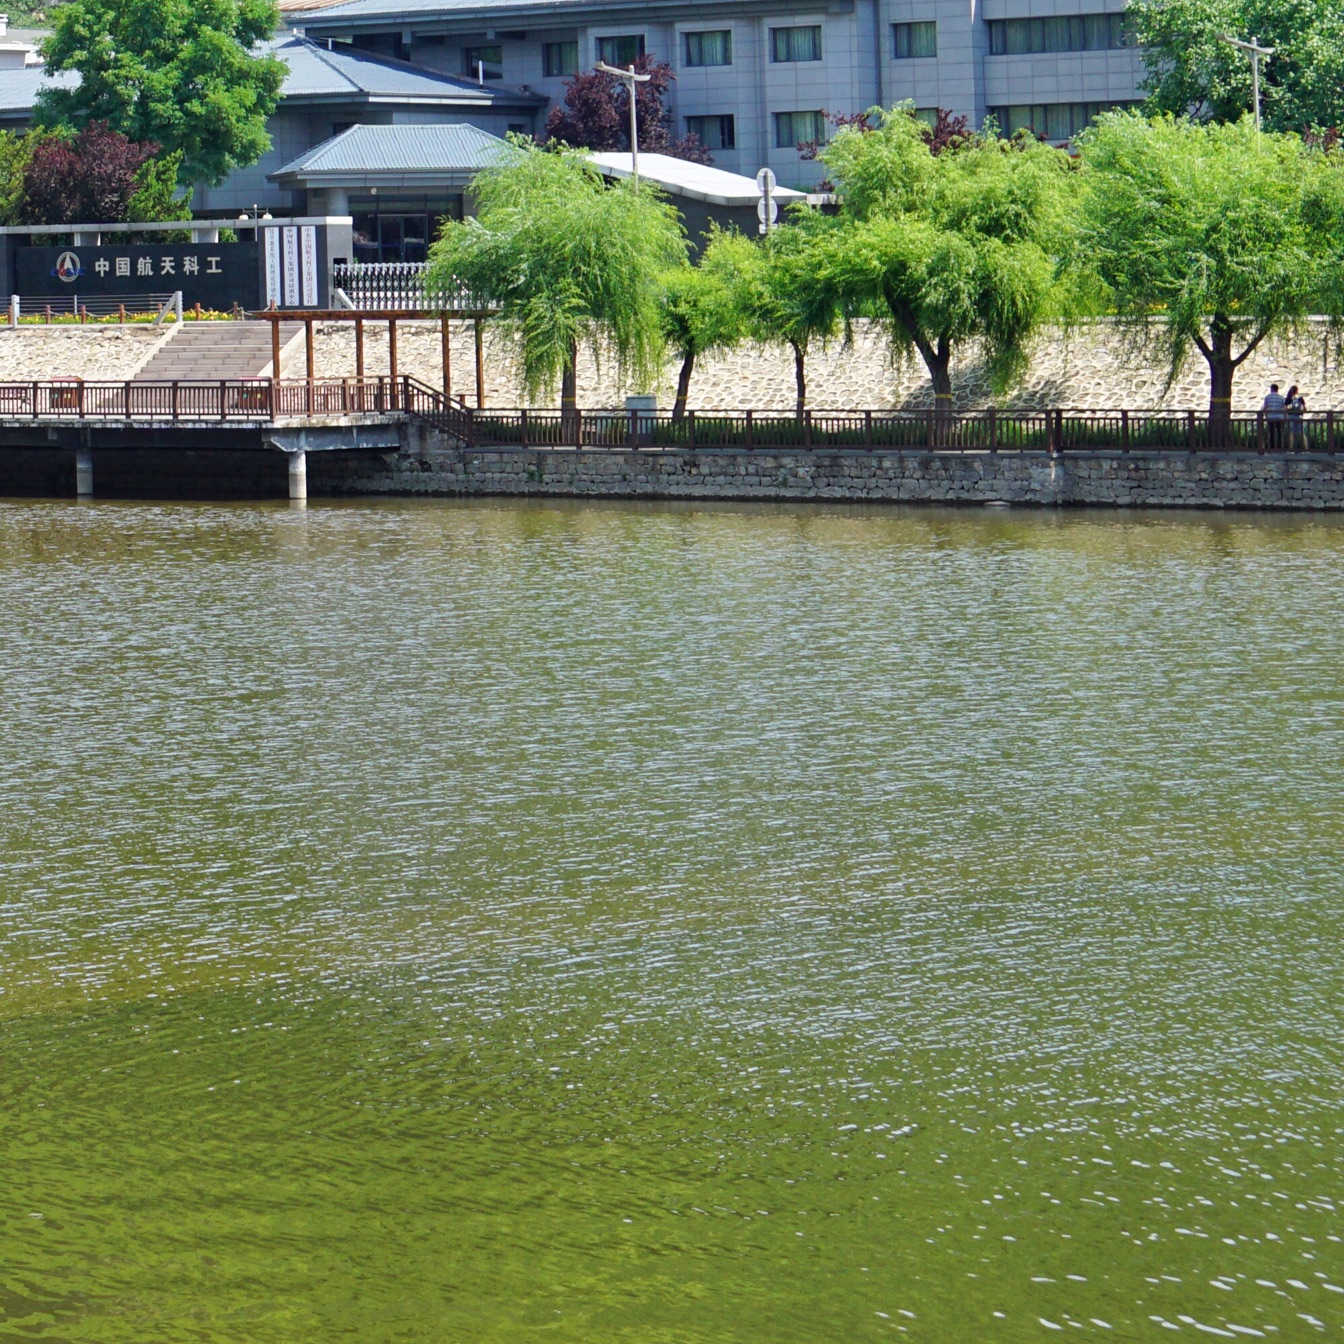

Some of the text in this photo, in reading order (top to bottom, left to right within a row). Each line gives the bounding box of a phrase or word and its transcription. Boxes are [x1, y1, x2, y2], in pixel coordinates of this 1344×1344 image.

[95, 256, 222, 277] 中国航天科工
